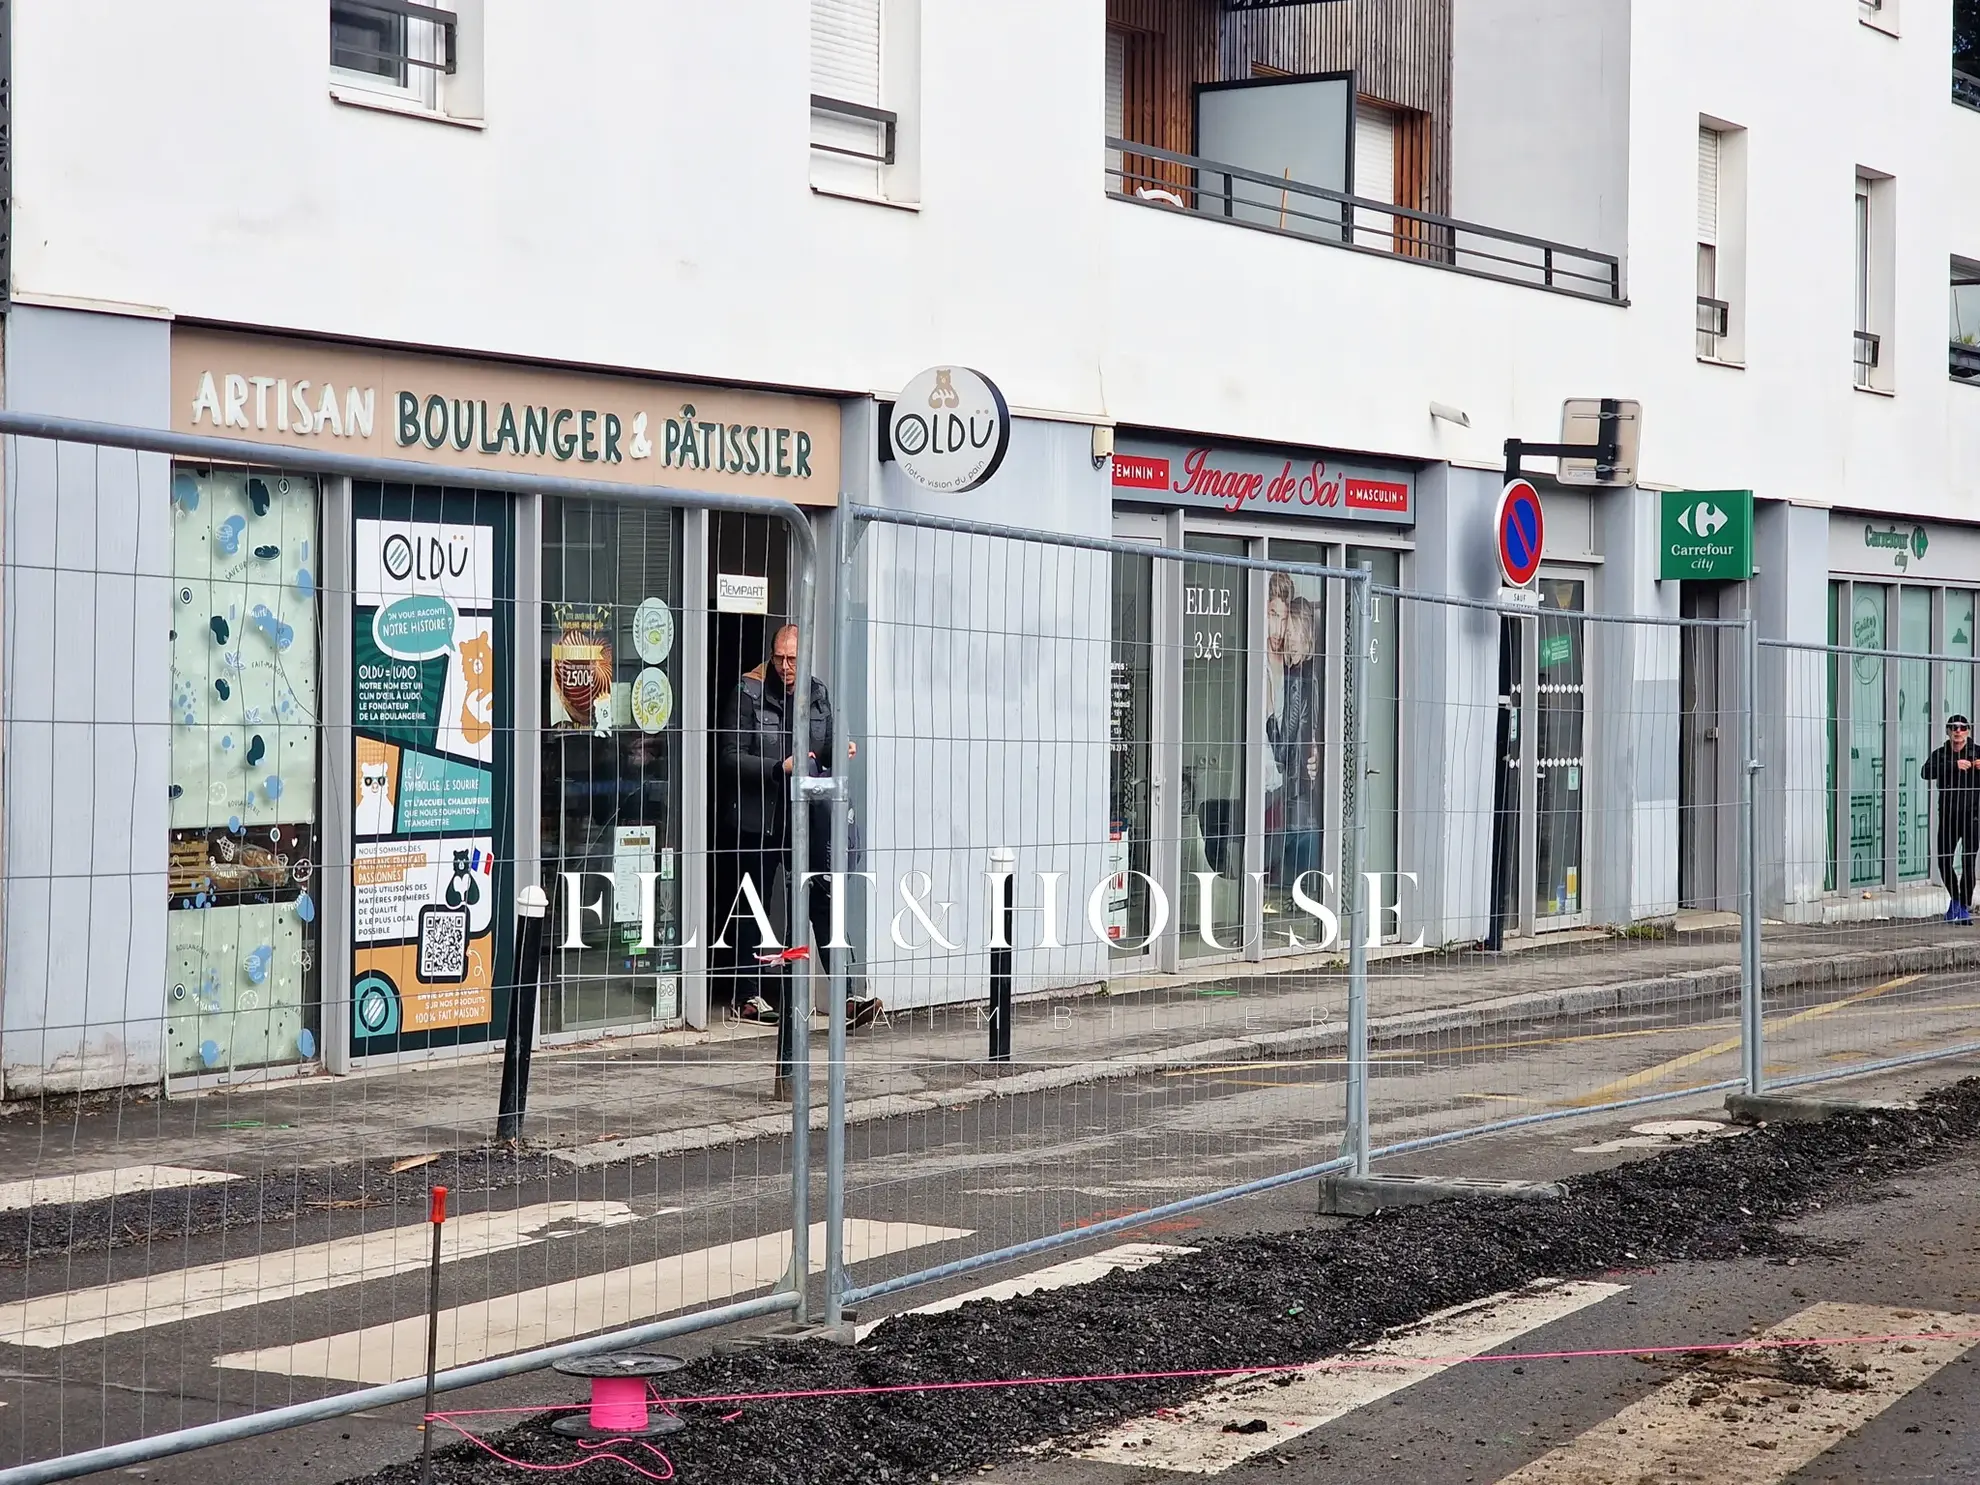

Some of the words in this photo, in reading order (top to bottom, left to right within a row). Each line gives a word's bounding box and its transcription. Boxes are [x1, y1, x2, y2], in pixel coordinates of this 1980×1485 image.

[192, 370, 375, 438] ARTISAN
[394, 390, 622, 464] BOULANGER
[629, 411, 652, 460] &
[660, 403, 812, 479] PÂTISSIER
[895, 409, 994, 455] OLDÜ
[927, 479, 952, 488] vision
[955, 475, 967, 486] du
[969, 460, 985, 480] pain
[1173, 447, 1263, 513] Image
[1266, 460, 1296, 503] de
[1298, 459, 1343, 508] Soi
[1355, 488, 1397, 503] MASCULIN
[1671, 543, 1734, 556] Carrefour
[383, 533, 468, 581] OLDÜ
[1691, 557, 1714, 572] city
[1186, 588, 1231, 615] ELLE
[398, 611, 415, 619] VOUS
[417, 608, 446, 617] RACONTE
[383, 622, 408, 637] NOTRE
[411, 619, 445, 633] HISTOIRE
[359, 682, 381, 690] NOTRE
[383, 682, 399, 690] NOM
[401, 682, 412, 690] EST
[413, 682, 423, 690] UN
[359, 692, 374, 700] CLIN
[359, 702, 367, 710] LE
[368, 702, 409, 710] FONDATEUR
[359, 712, 368, 720] DE
[370, 712, 379, 720] LA
[380, 712, 426, 720] BOULANGERIE
[404, 768, 412, 779] LE
[404, 780, 440, 792] SYMBOLISE
[452, 779, 479, 790] SOURIRE
[404, 799, 412, 807] ET
[447, 797, 489, 805] CHALEUREUX
[404, 810, 418, 818] QUE
[420, 809, 437, 817] NOUS
[439, 807, 480, 816] SOUHAITONS
[404, 819, 449, 828] TRANSMETTRE
[379, 845, 407, 854] SOMMES
[408, 844, 421, 852] DES
[359, 870, 401, 884] PASSIONNÉS
[379, 884, 413, 893] UTILISONS
[359, 895, 391, 904] MATIÈRES
[394, 893, 430, 902] PREMIÈRES
[369, 905, 397, 915] QUALITÉ
[374, 916, 391, 924] PLUS
[393, 914, 414, 922] LOCAL
[359, 927, 390, 936] POSSIBLE
[440, 1000, 453, 1008] NOS
[454, 997, 486, 1006] PRODUITS
[438, 1010, 452, 1020] FAIT
[454, 1007, 479, 1019] MAISON
